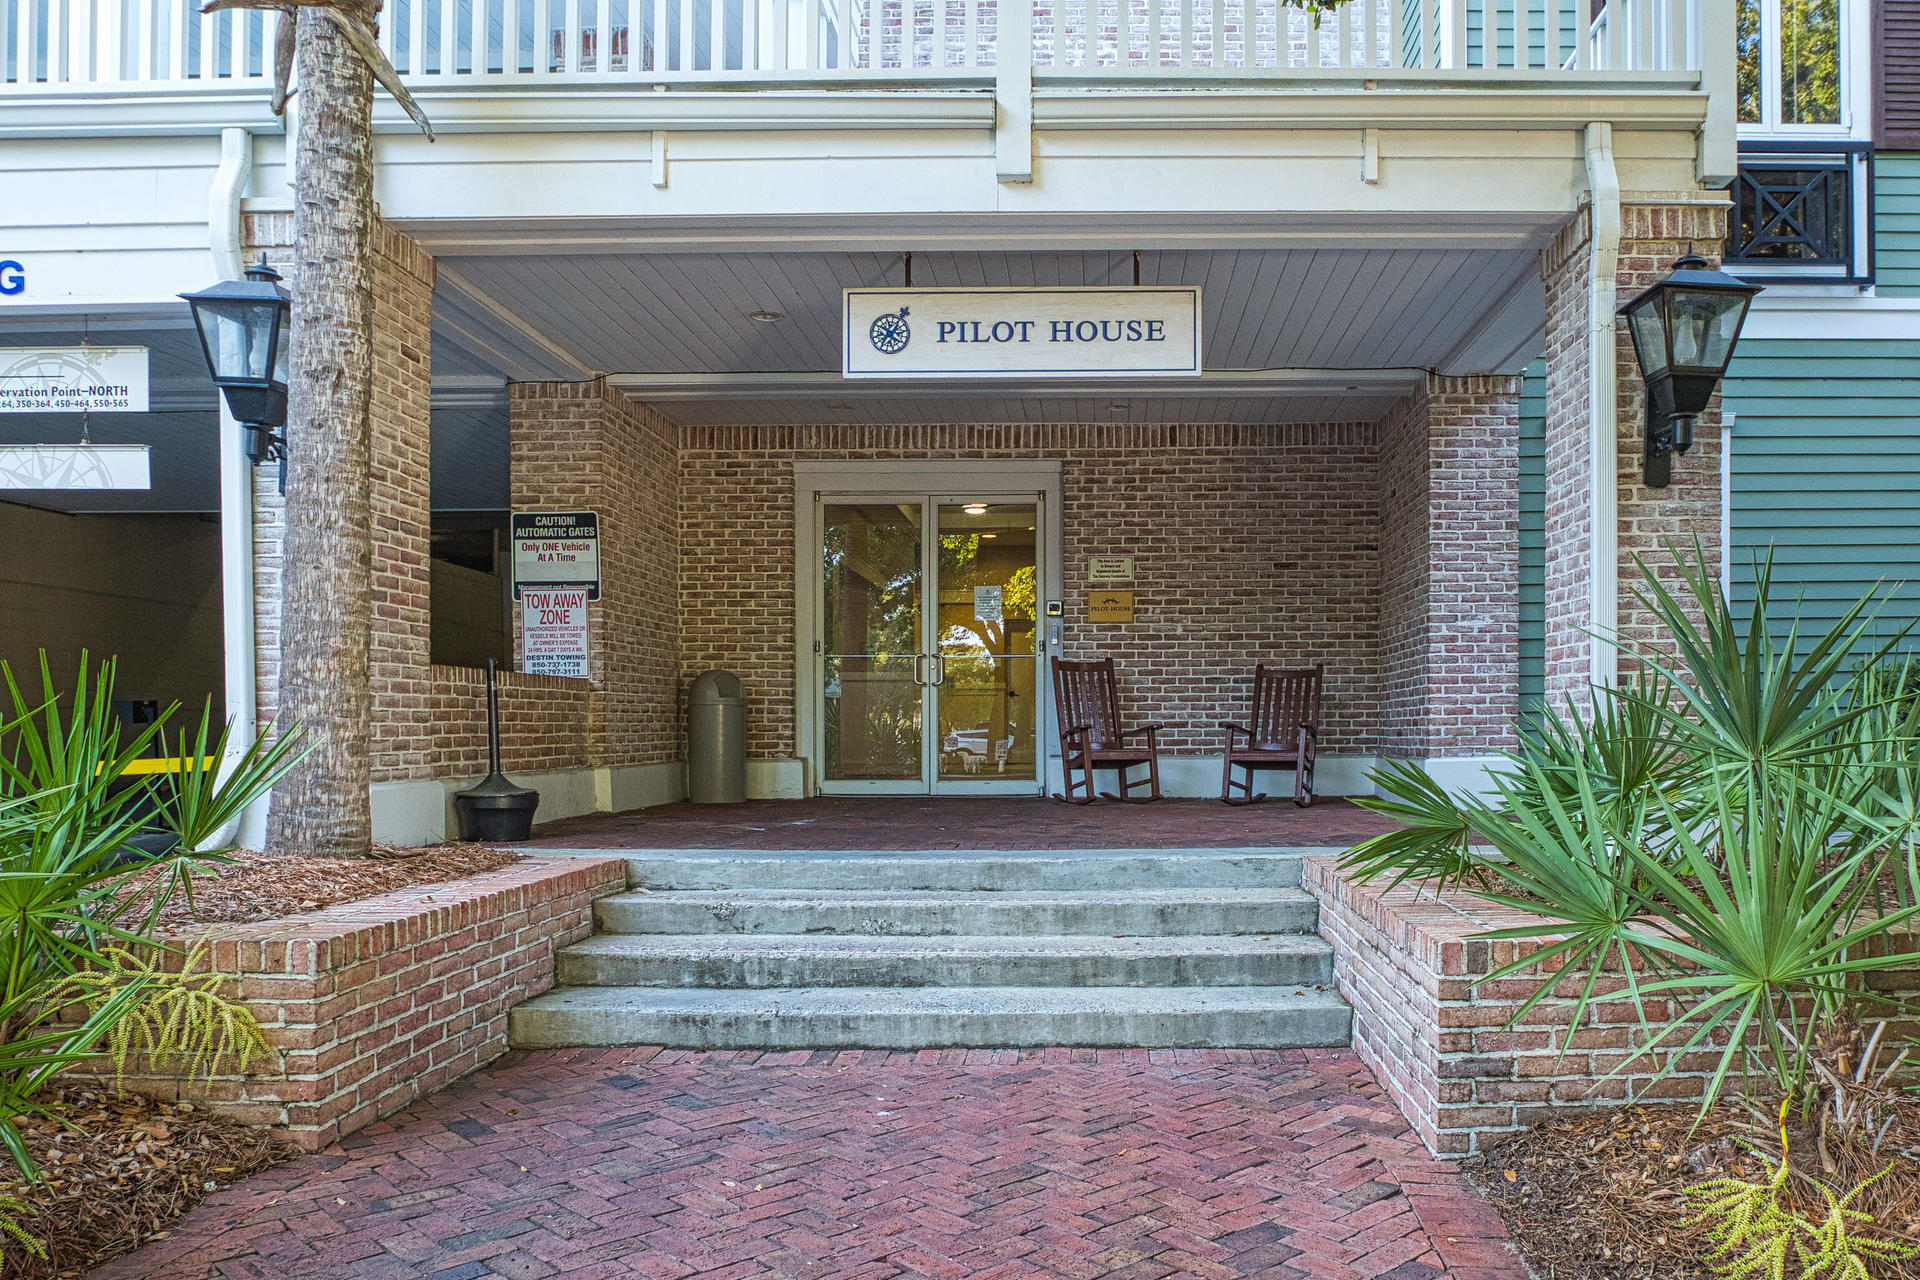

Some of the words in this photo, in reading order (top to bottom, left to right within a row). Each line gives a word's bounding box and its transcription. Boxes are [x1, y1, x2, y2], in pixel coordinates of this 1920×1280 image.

[0, 260, 25, 296] G
[936, 320, 1035, 343] PILOT
[1048, 319, 1167, 343] HOUSE
[0, 386, 48, 397] ervation
[535, 516, 576, 526] CAUTION!
[516, 527, 567, 537] AUTOMATIC
[568, 526, 595, 536] GATES
[521, 542, 540, 553] Only
[542, 542, 559, 551] ONE
[561, 542, 590, 551] Vehicle
[537, 553, 546, 561] At
[548, 553, 554, 561] A
[555, 552, 576, 561] Time
[525, 593, 551, 609] TOW
[553, 593, 584, 609] AWAY
[540, 609, 571, 625] ZONE
